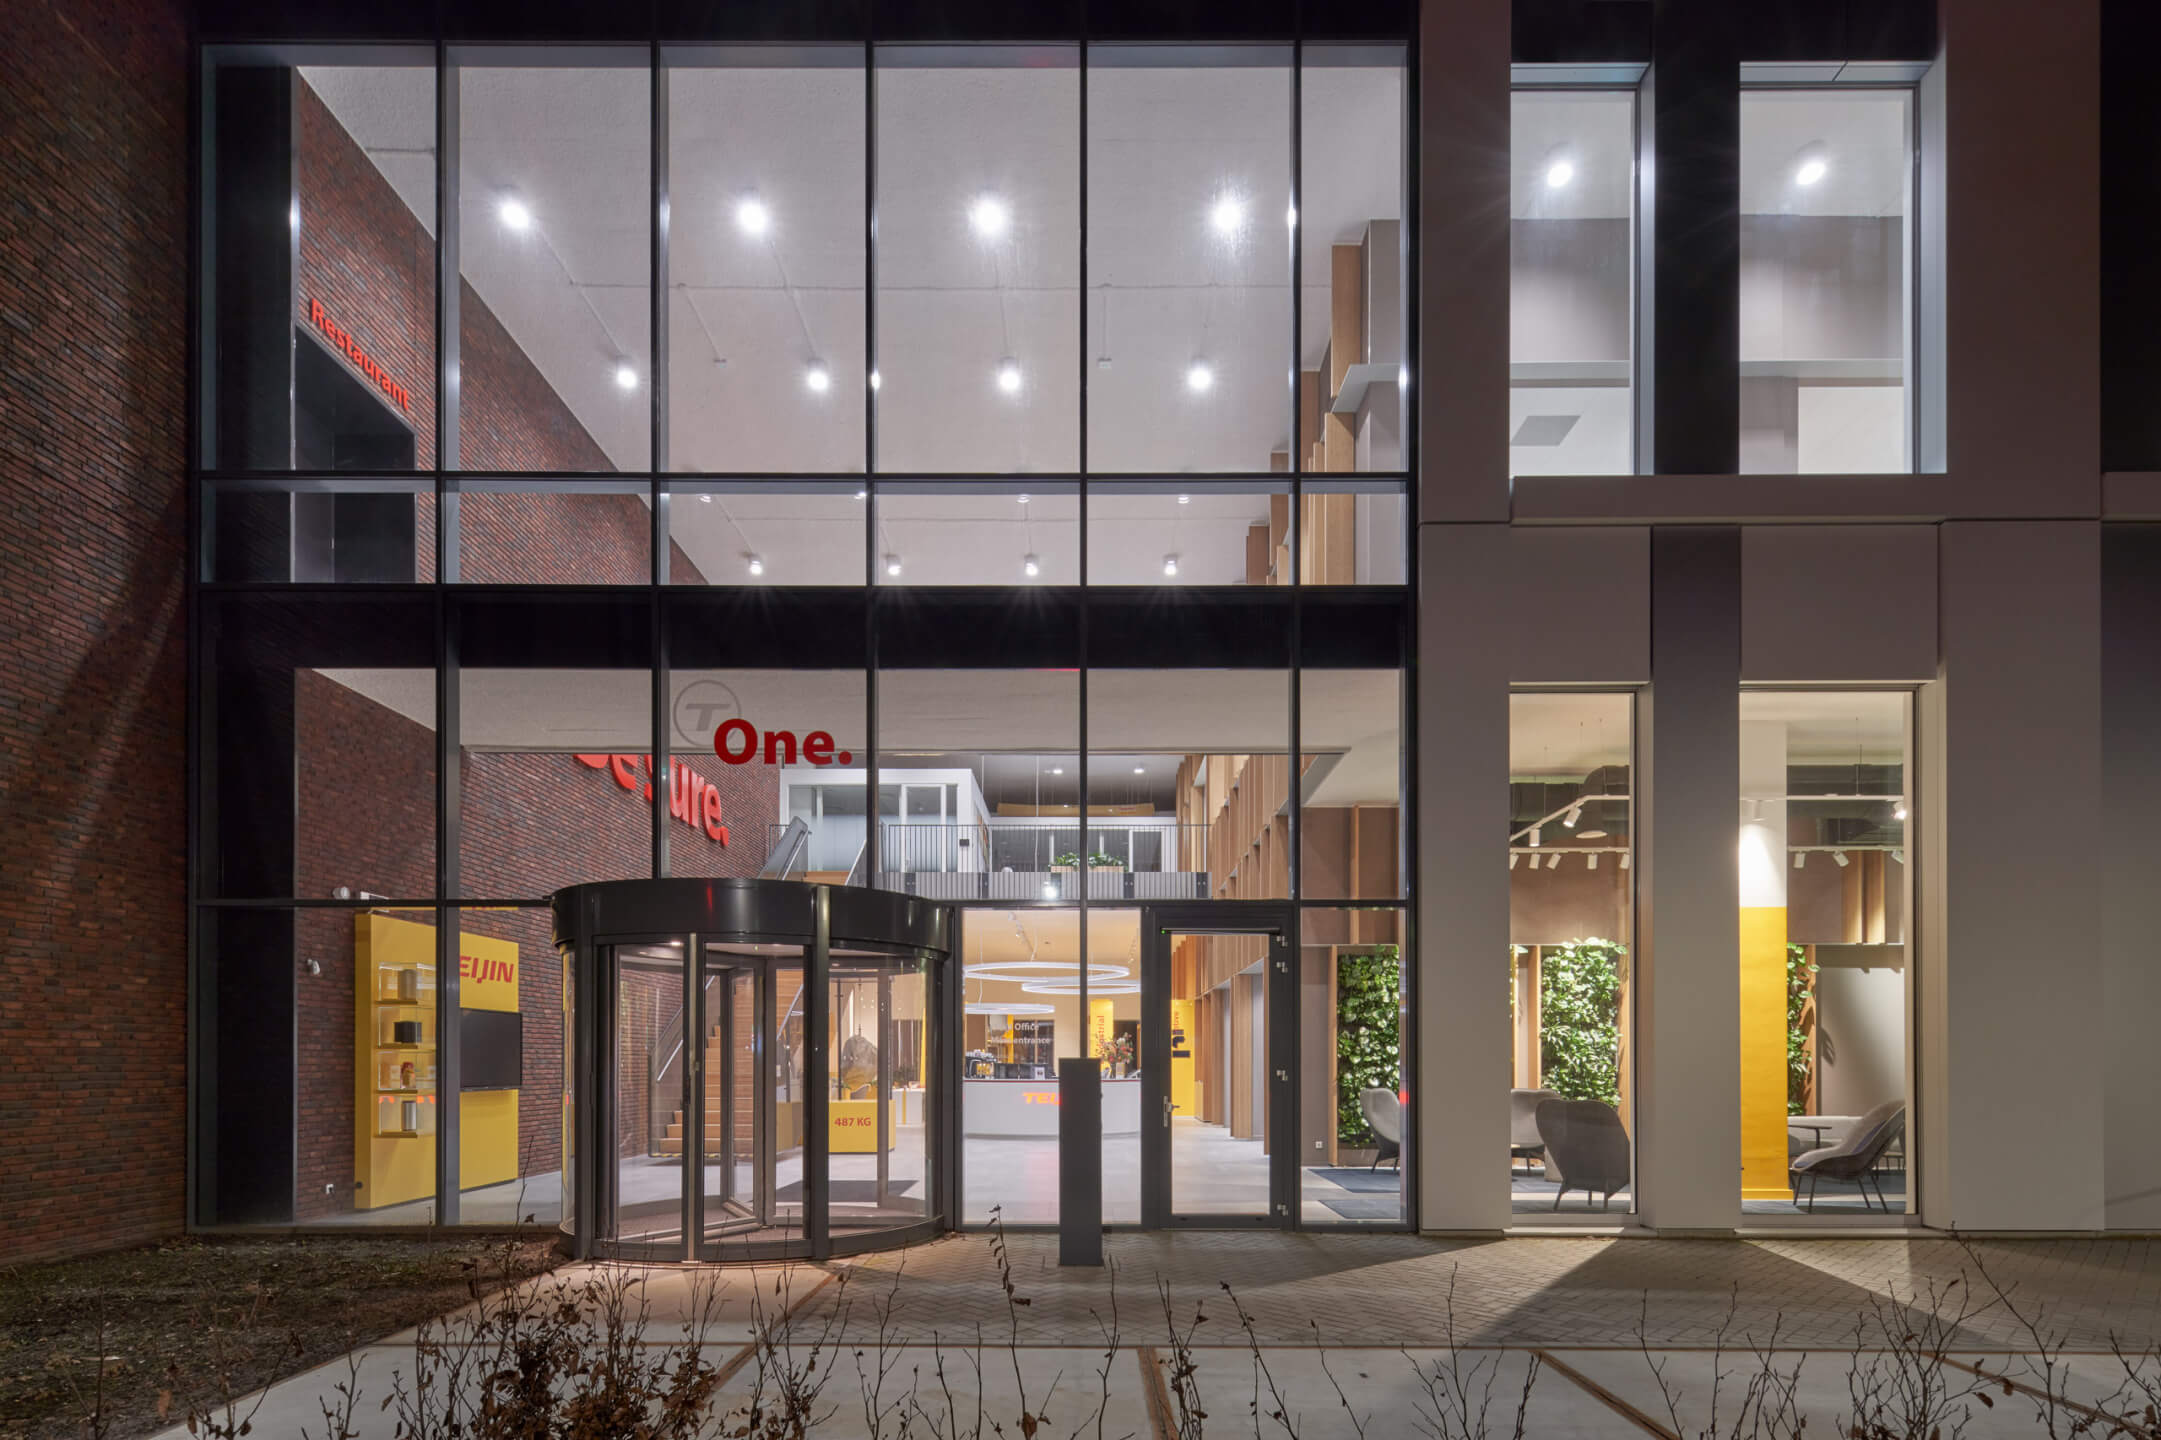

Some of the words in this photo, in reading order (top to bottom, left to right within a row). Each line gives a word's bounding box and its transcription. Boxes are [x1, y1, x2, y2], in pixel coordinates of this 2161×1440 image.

[311, 298, 409, 411] Restaurant
[714, 718, 853, 765] One.
[459, 955, 514, 984] EIJIN
[1014, 1022, 1040, 1031] Office
[834, 1117, 855, 1127] 487
[857, 1117, 872, 1127] KG
